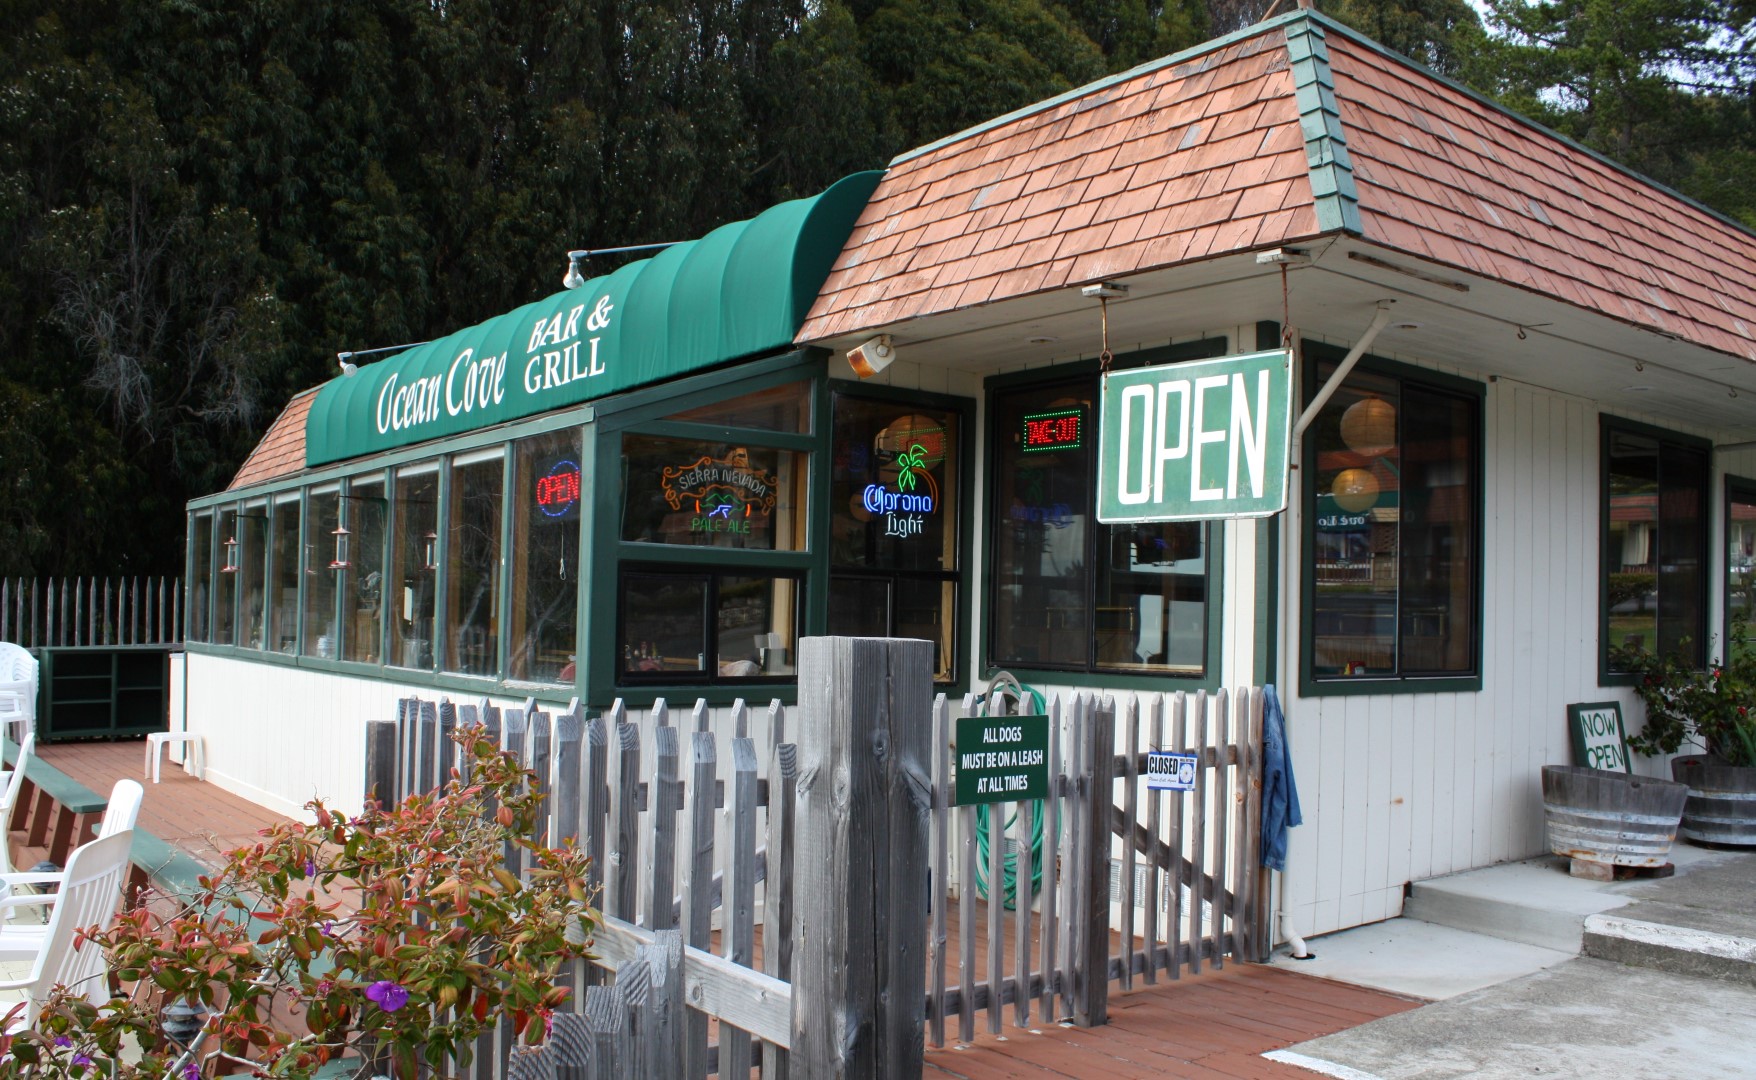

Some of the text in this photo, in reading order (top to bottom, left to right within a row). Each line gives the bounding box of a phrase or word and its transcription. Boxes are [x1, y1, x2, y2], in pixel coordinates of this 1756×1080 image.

[527, 294, 614, 353] BAR &
[524, 337, 606, 394] GRILL
[376, 348, 507, 434] Ocean Cove
[1117, 369, 1270, 505] OPEN
[537, 471, 581, 505] OPEN
[679, 467, 767, 497] SIERRA NEVADA
[863, 484, 933, 515] Corona
[692, 517, 750, 534] PALE ALE
[885, 512, 924, 538] Light
[983, 726, 1022, 743] ALL DOGS
[1581, 712, 1615, 738] NOW
[962, 750, 1043, 769] MUST BE ON A LEASH
[1149, 756, 1178, 775] CLOSED
[1587, 744, 1624, 769] OPEN
[977, 774, 1028, 793] AT ALL TIMES
